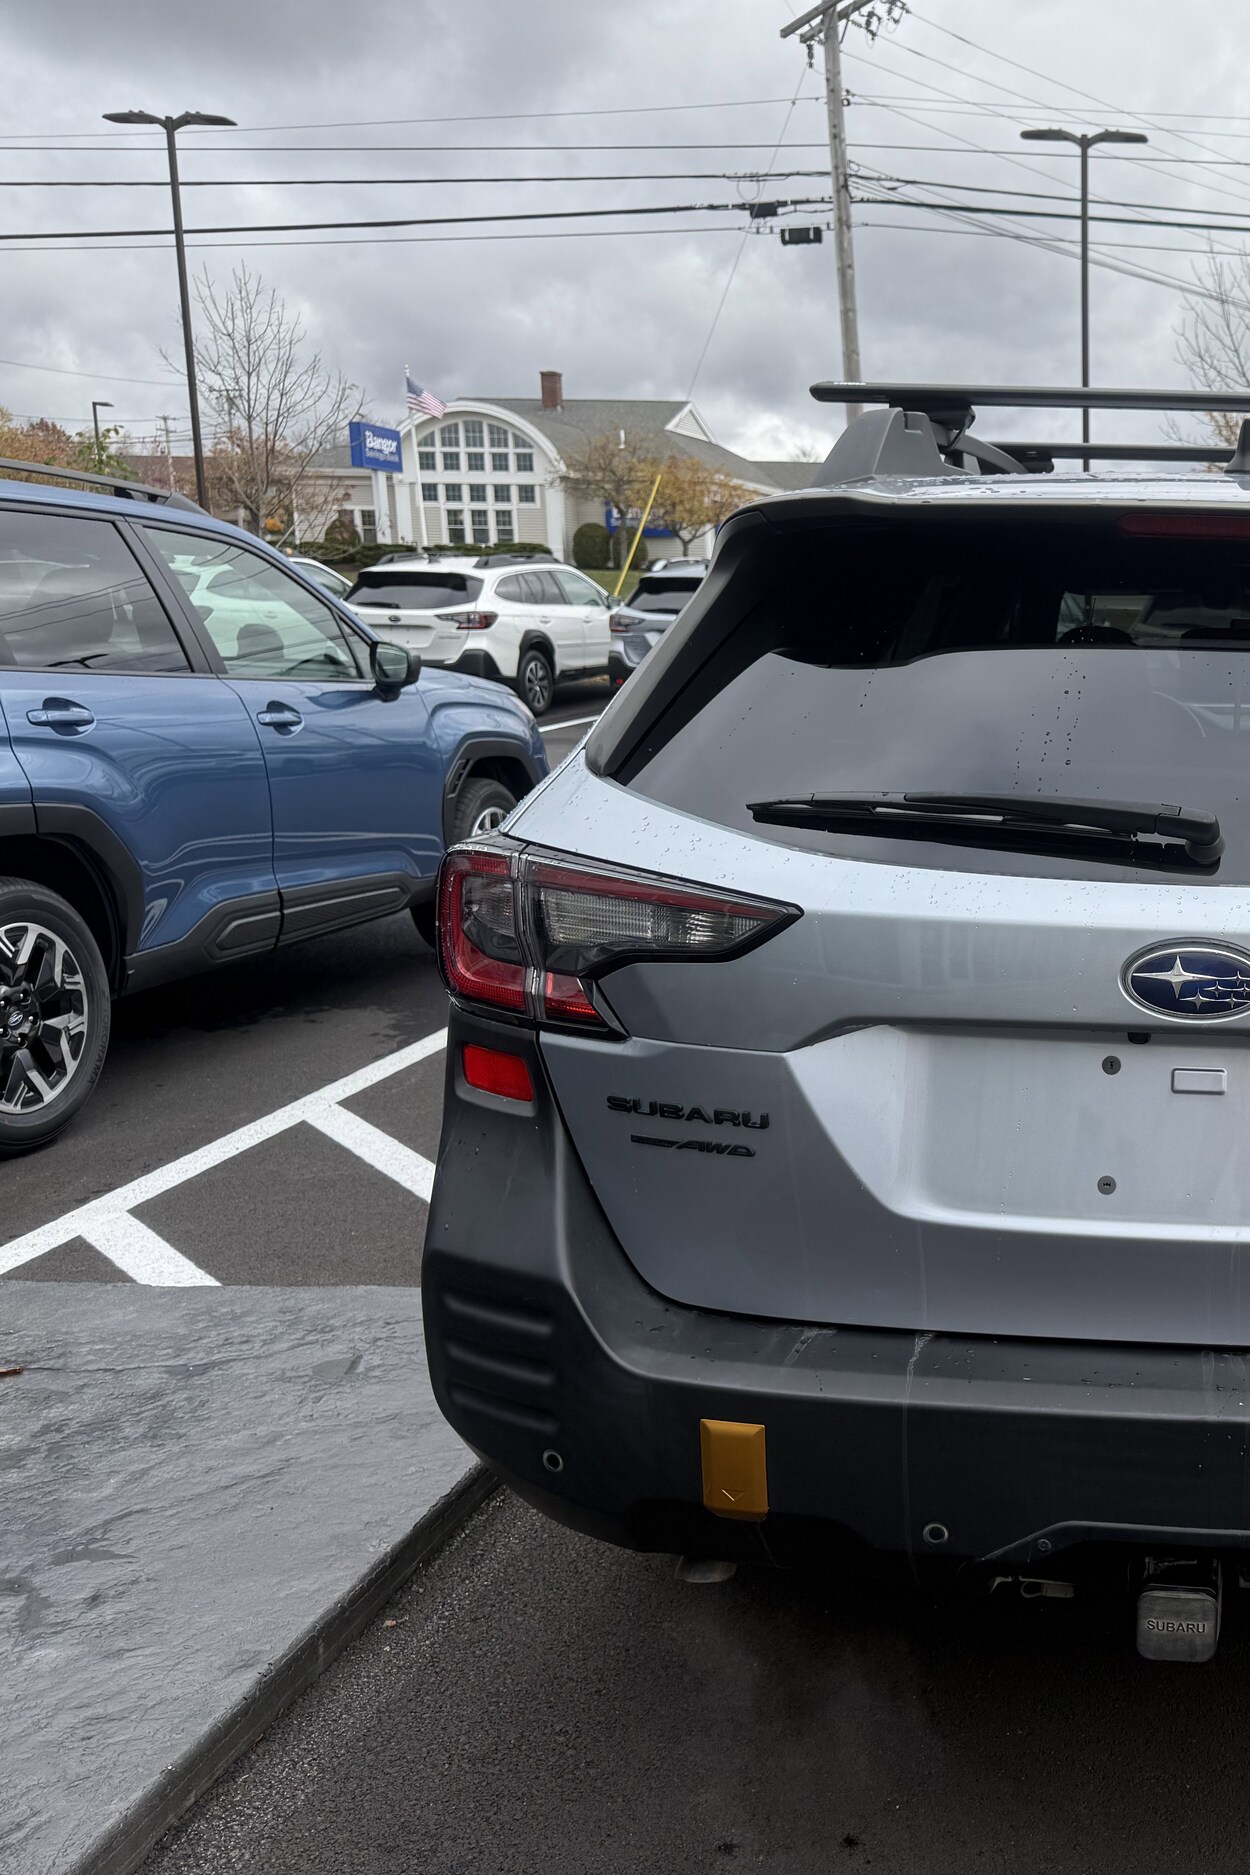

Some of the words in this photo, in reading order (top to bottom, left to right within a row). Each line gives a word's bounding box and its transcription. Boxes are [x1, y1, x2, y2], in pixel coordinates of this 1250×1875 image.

[365, 430, 397, 454] Bangor
[606, 1094, 769, 1130] SUBARU
[675, 1139, 757, 1158] AWD
[1146, 1619, 1206, 1634] SUBARU
